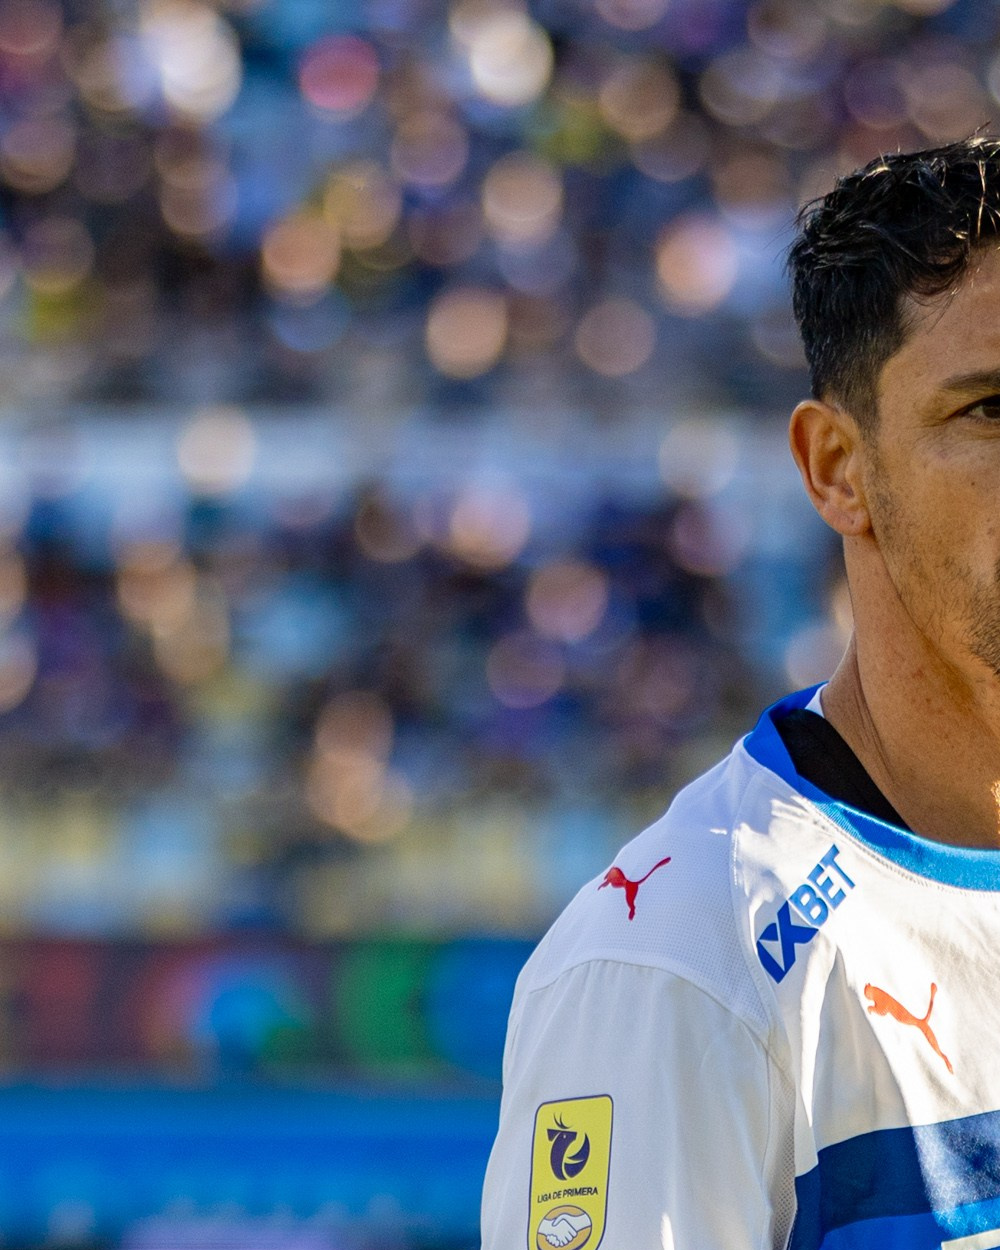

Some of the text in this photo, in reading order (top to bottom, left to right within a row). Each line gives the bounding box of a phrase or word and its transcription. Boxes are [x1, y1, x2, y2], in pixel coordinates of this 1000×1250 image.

[537, 1186, 599, 1204] LIGA DE PRIMERA
